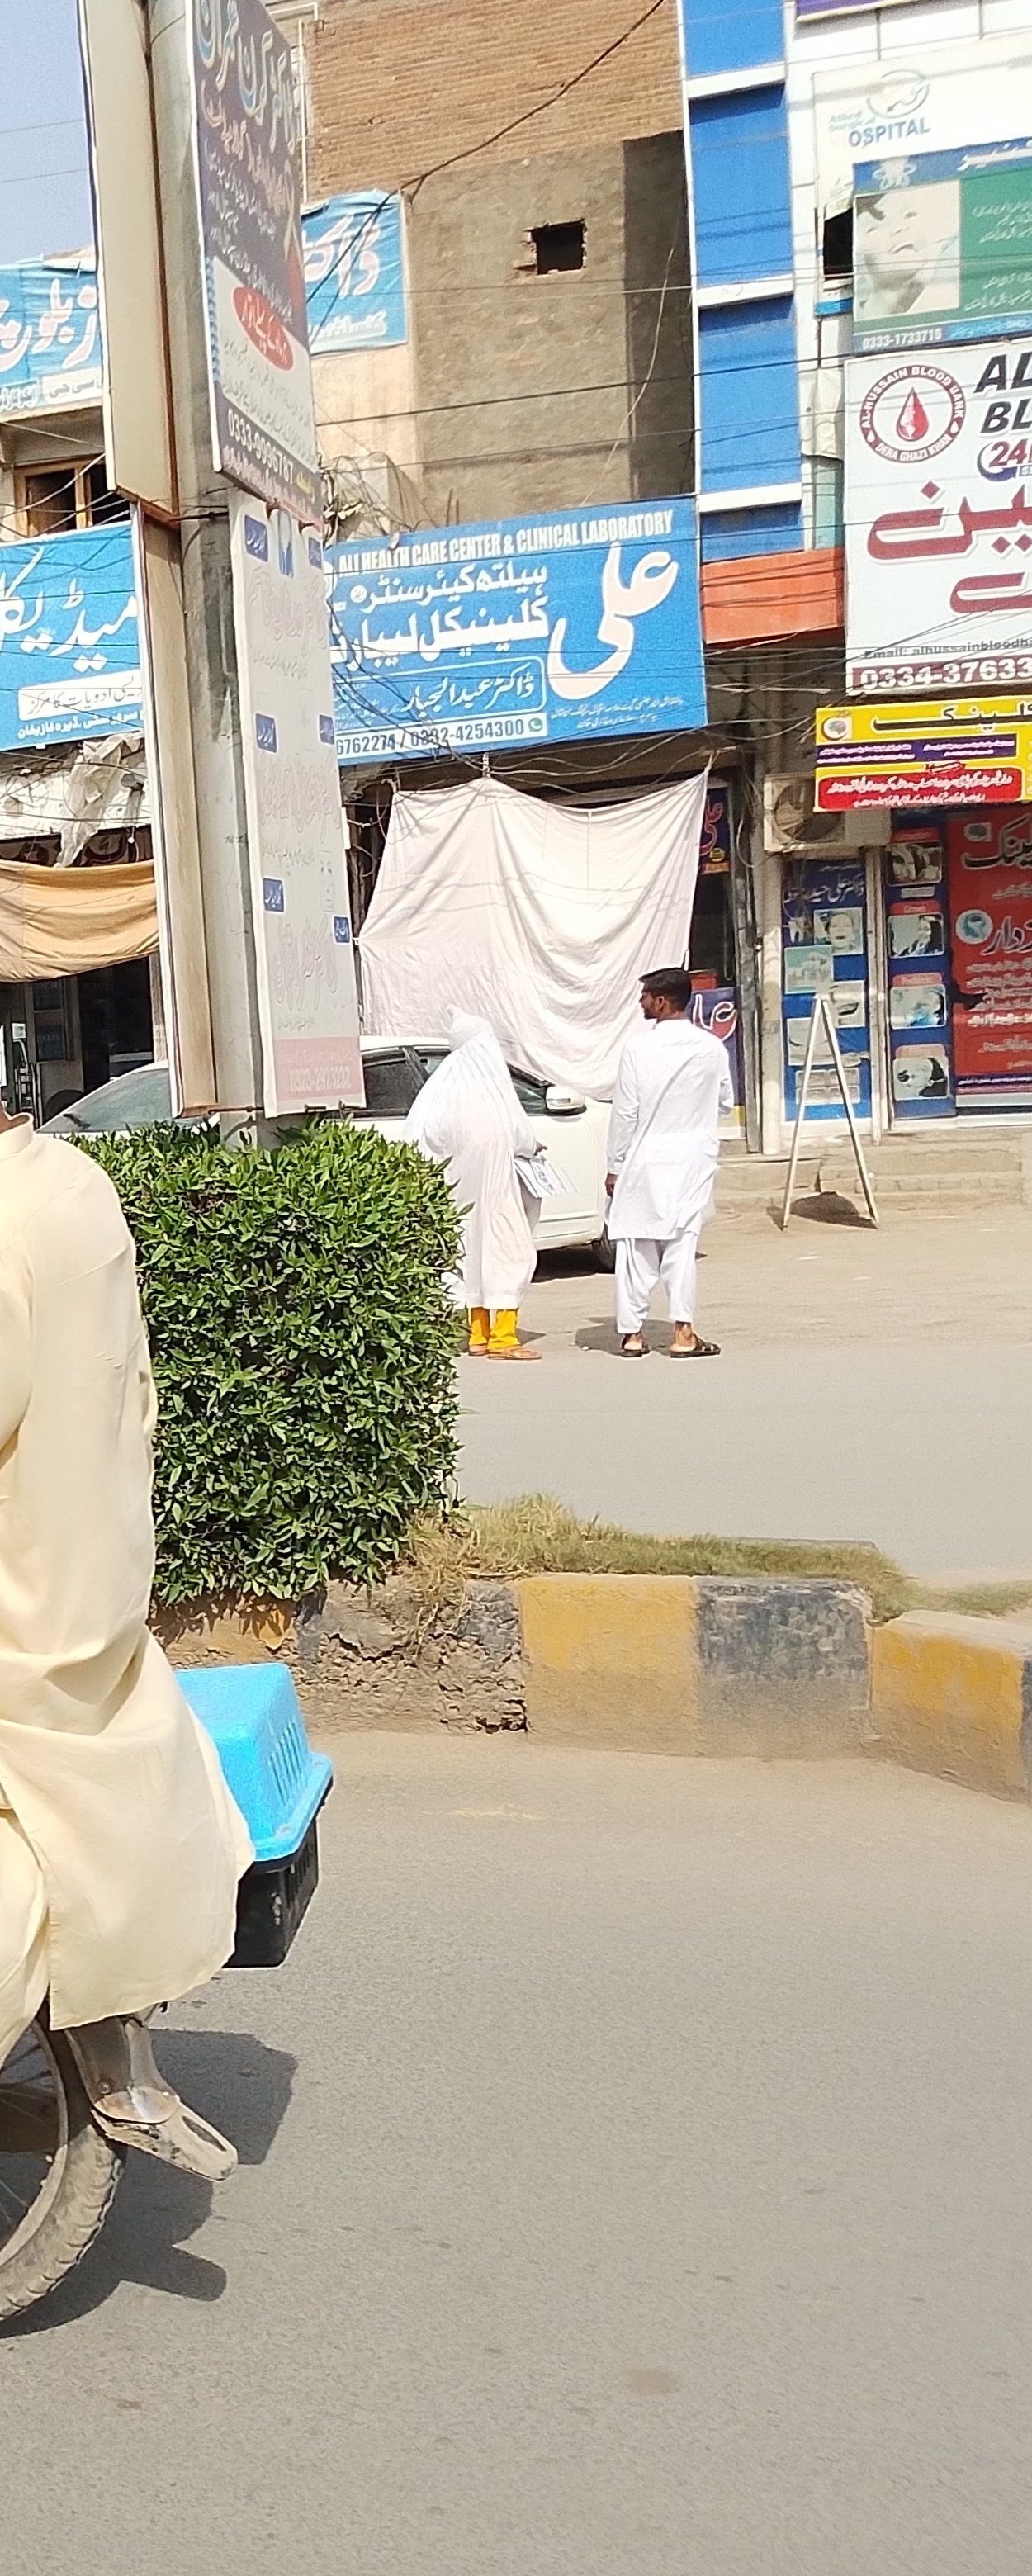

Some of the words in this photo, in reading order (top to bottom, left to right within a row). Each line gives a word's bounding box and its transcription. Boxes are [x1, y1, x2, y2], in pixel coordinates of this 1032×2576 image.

[861, 367, 908, 429] AL-HUSSAIN
[911, 367, 952, 386] BLOOD
[875, 443, 898, 462] DERA
[900, 448, 929, 462] GHAZI
[928, 433, 953, 456] KHAN
[338, 553, 360, 577] ALI
[361, 546, 409, 575] HEALTH
[411, 540, 448, 566] CARE
[448, 533, 502, 562] CENTER
[503, 534, 514, 556] &
[516, 523, 580, 553] CLINICAL
[581, 509, 674, 545] LABORATORY
[547, 542, 679, 700] علی
[484, 662, 535, 710] ڈاکٹر
[693, 994, 737, 1040] عل
